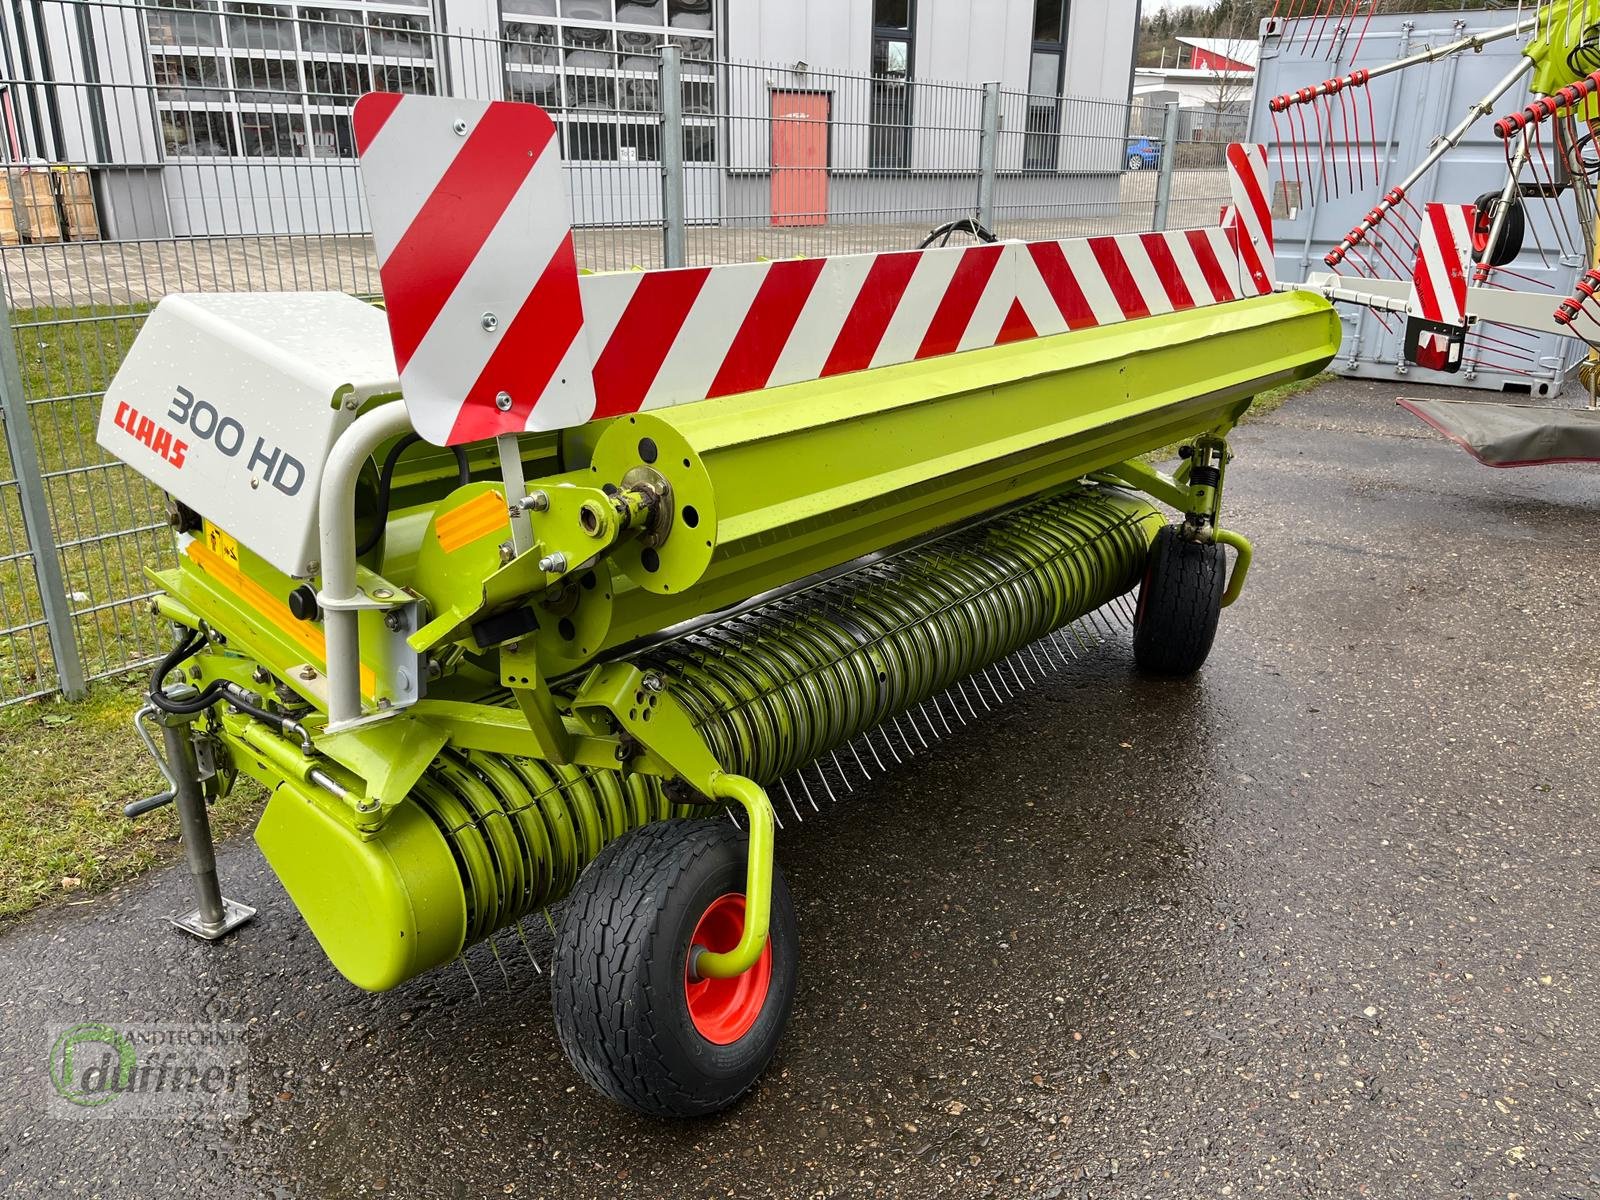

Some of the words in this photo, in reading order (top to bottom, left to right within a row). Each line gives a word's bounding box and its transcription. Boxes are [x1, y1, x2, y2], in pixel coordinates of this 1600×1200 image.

[113, 400, 189, 469] CLAAS
[167, 385, 245, 457] 300
[247, 437, 305, 497] HD
